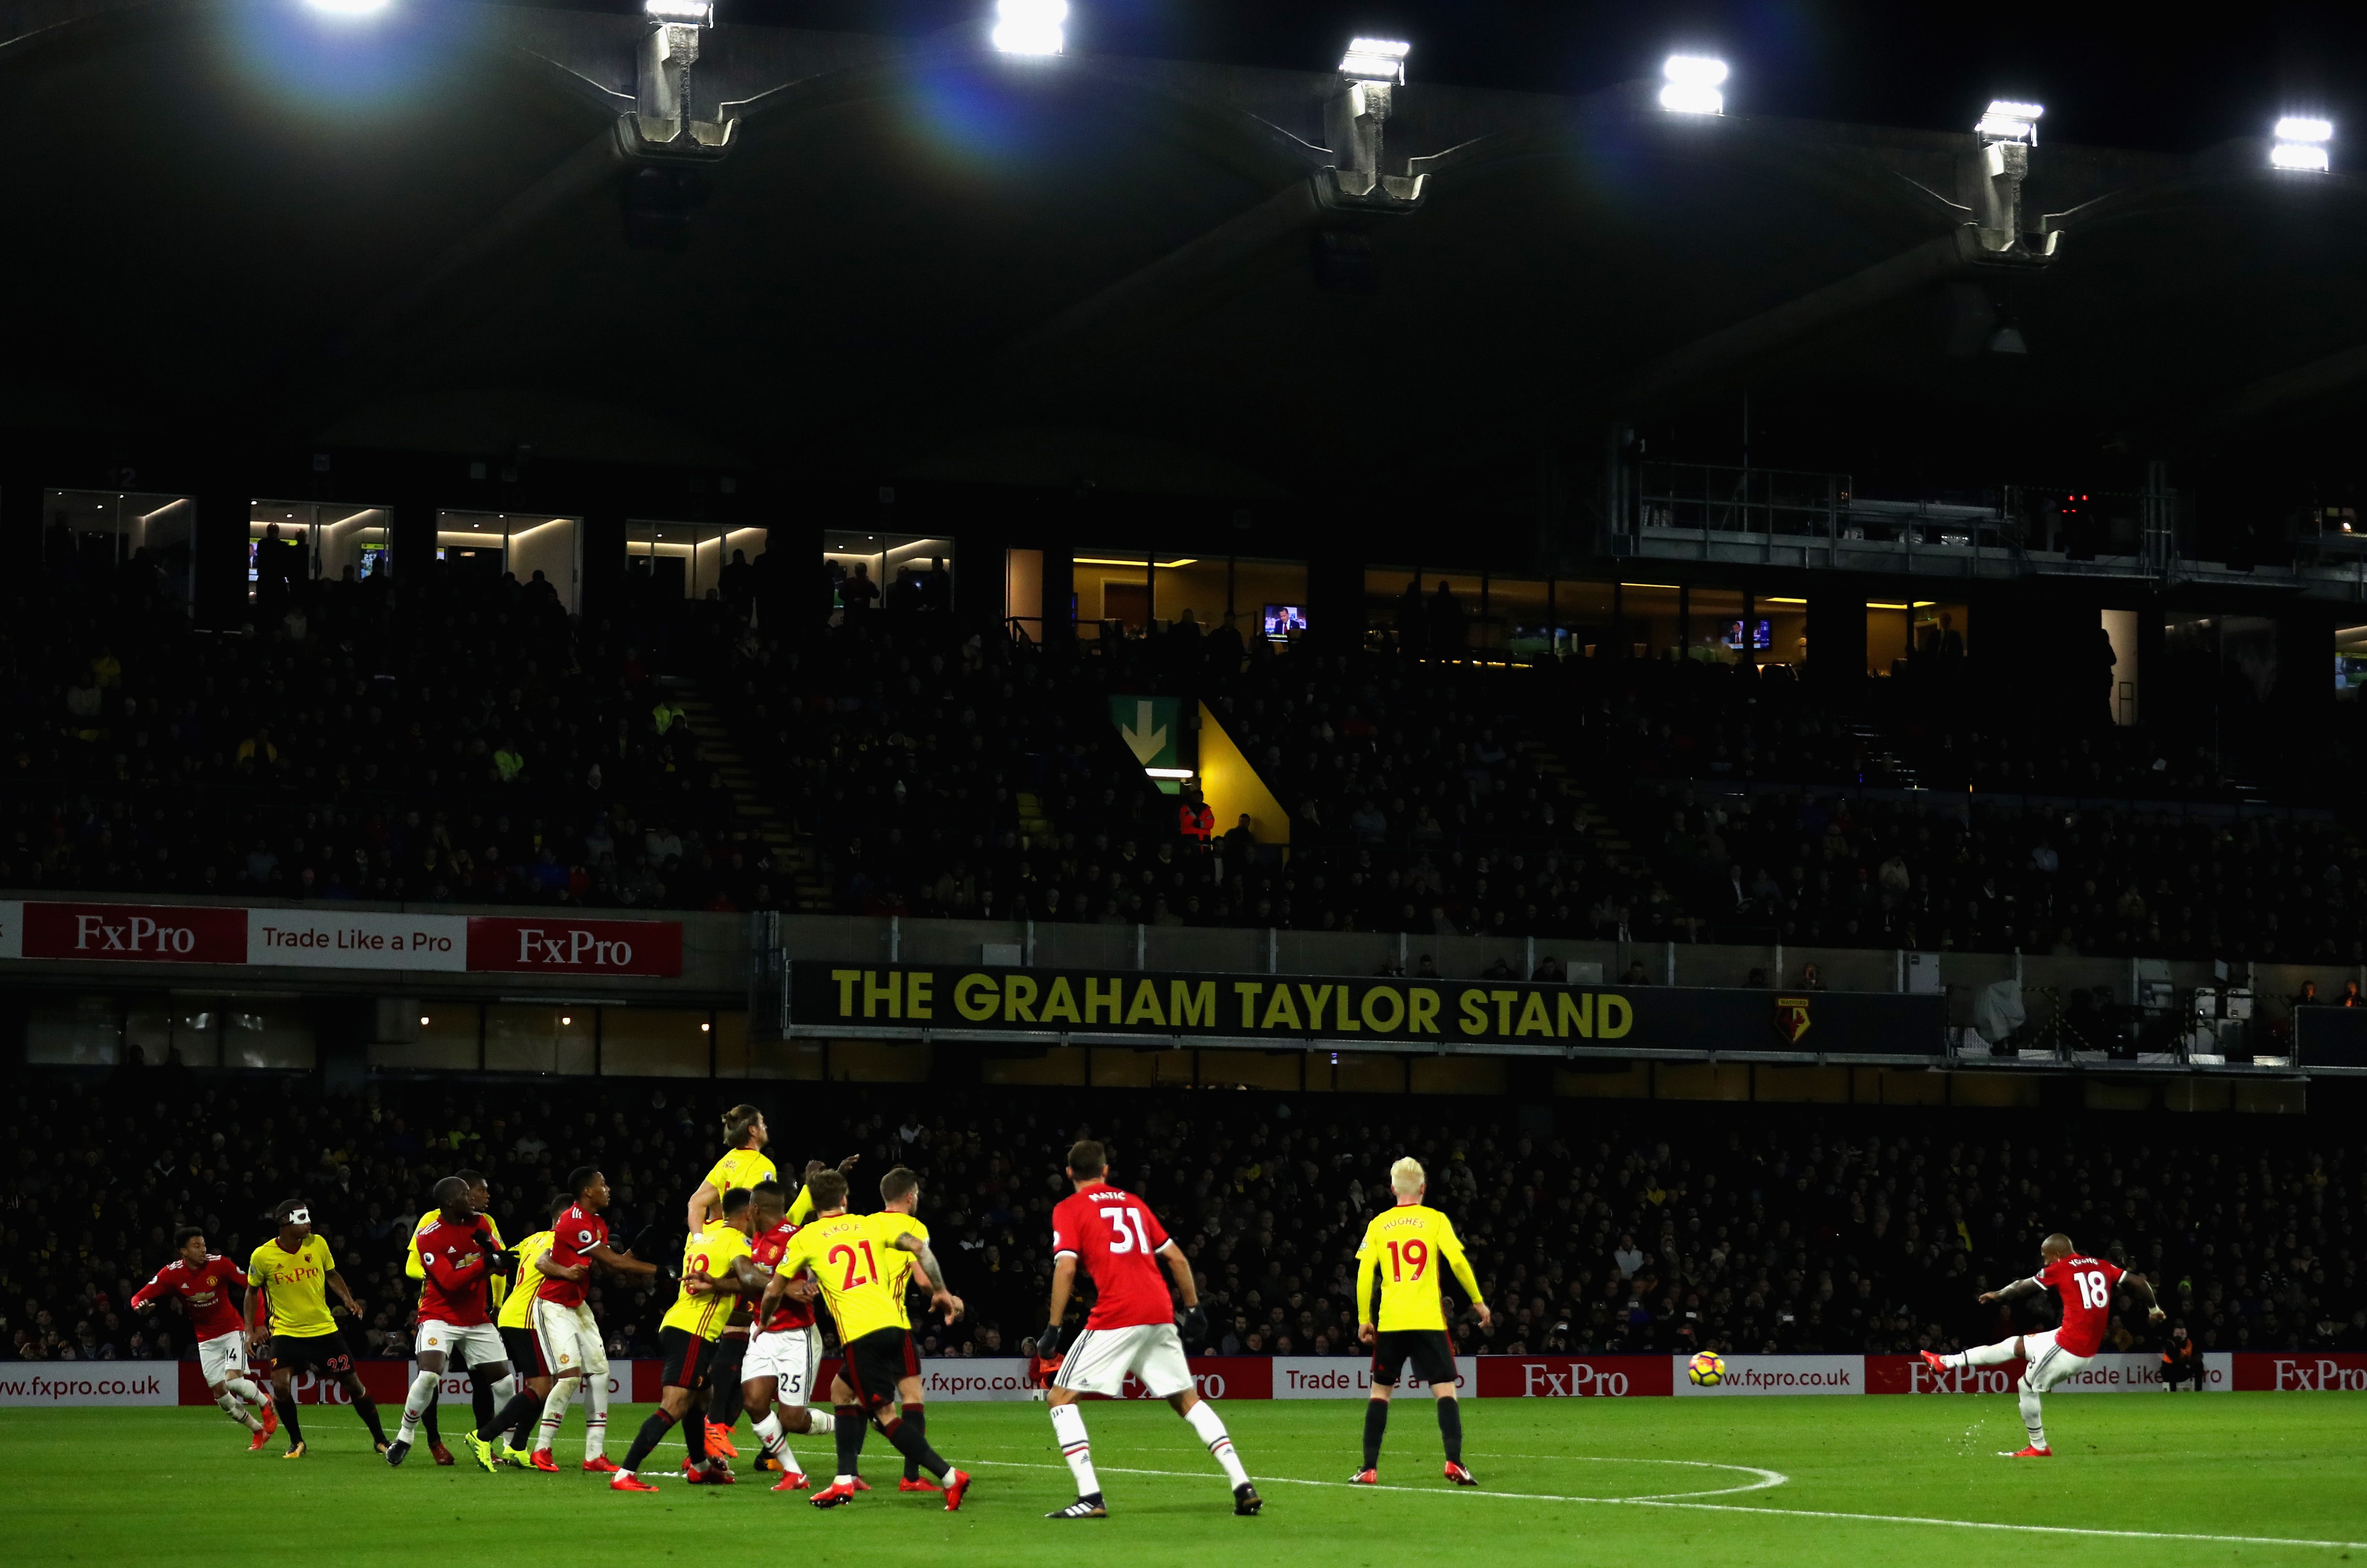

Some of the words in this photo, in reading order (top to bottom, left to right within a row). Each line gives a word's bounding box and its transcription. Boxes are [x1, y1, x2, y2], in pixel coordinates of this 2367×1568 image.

[74, 915, 195, 953] FxPro
[263, 918, 329, 947] Trade
[338, 920, 384, 949] Like
[391, 936, 404, 950] a
[413, 932, 452, 951] Pro
[517, 929, 632, 965] FxPro
[831, 969, 933, 1019] THE
[953, 973, 1216, 1027] GRAHAM
[1234, 982, 1441, 1034] TAYLOR
[1458, 988, 1633, 1040] STAND
[821, 1223, 849, 1238] KIKO
[1100, 1207, 1149, 1254] 31
[1383, 1217, 1425, 1231] HUGHES
[273, 1267, 318, 1285] FxPro
[828, 1239, 878, 1291] 21
[1387, 1238, 1428, 1282] 19
[2074, 1271, 2108, 1309] 18
[226, 1348, 237, 1361] 14
[327, 1354, 351, 1373] 22
[0, 1376, 160, 1399] w.fxpro.co.uk
[780, 1373, 801, 1393] 25
[1286, 1370, 1350, 1389] Trade
[1521, 1363, 1629, 1397] FxPro
[1689, 1369, 1850, 1389] w.fxpro.co.uk
[1907, 1361, 2009, 1394] FxPro
[2273, 1360, 2367, 1391] FxPro
